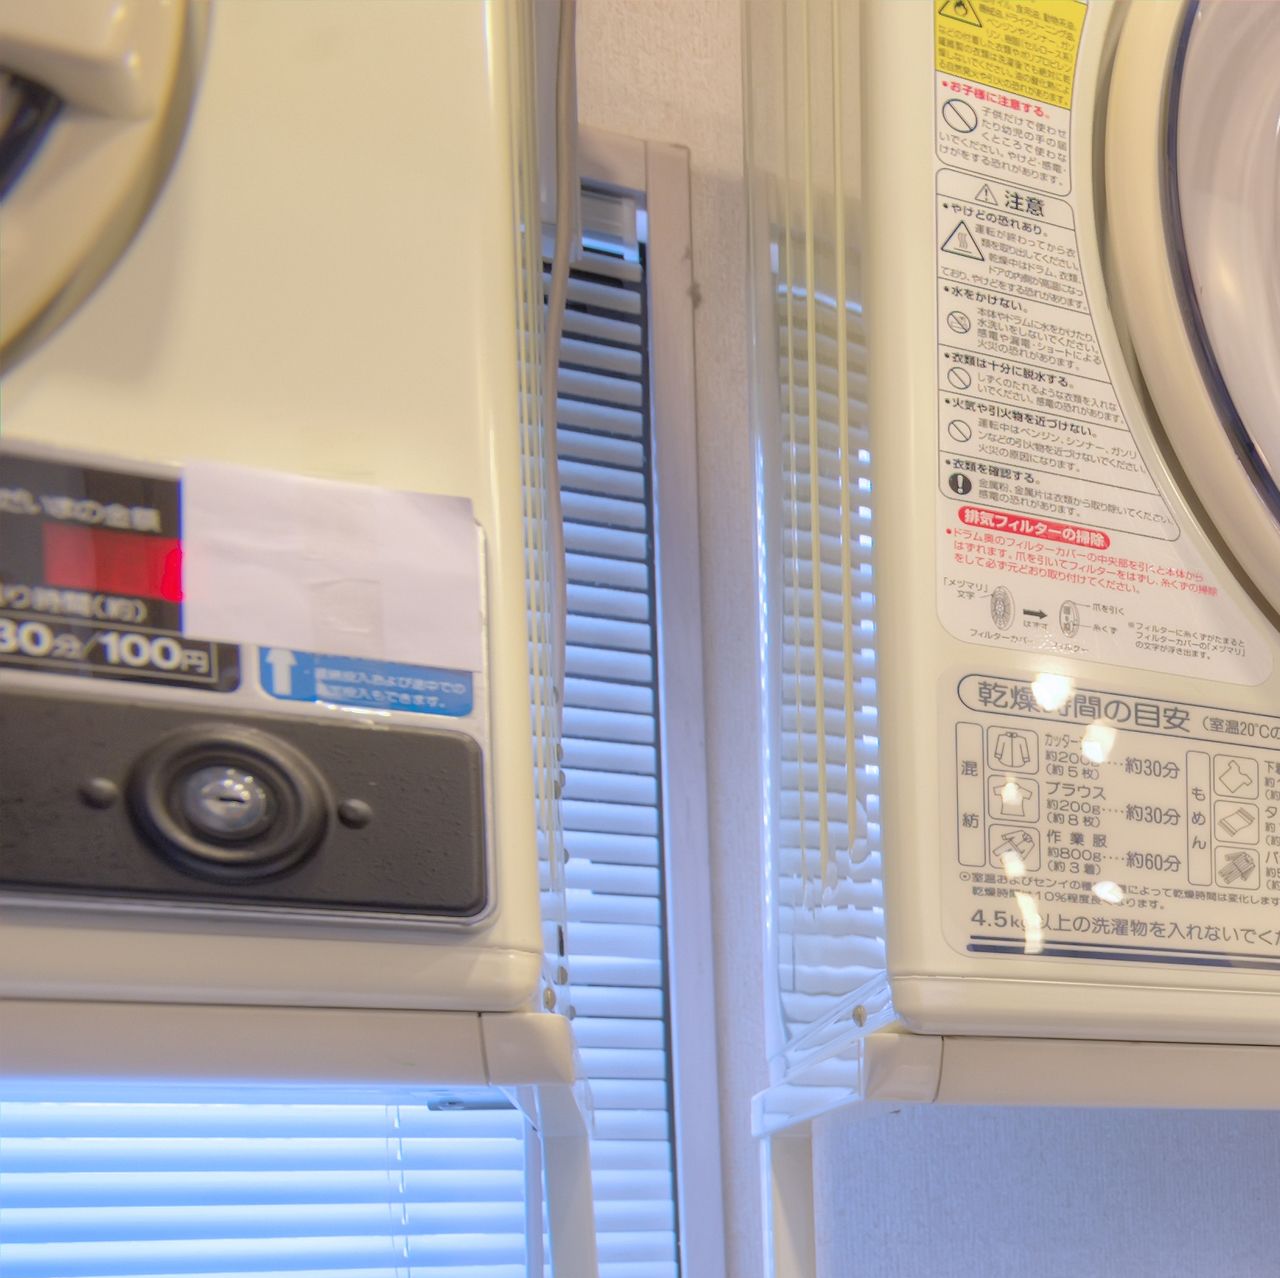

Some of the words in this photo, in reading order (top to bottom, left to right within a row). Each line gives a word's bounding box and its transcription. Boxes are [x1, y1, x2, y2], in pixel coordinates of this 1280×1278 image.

[950, 81, 1050, 119] お子様に注意する。
[981, 106, 1067, 139] 子供だけで使わせ
[981, 119, 1067, 151] たり幼児の手の届
[981, 131, 1067, 163] くところで使わな
[939, 144, 1063, 186] けがをする恐れがあります。
[1004, 189, 1045, 217] 注意
[951, 203, 1048, 237] やけどの恐れあり。
[975, 224, 1076, 258] 運転が終わってから衣
[951, 286, 1029, 313] 水をかけない。
[952, 352, 1074, 389] 衣類は十分に脱水する。
[977, 339, 1081, 371] 火災の恐れがあります。
[977, 373, 1118, 411] しずくのたれるような衣類を入れな
[952, 398, 1097, 439] 火気や引火物を近づけない。
[953, 458, 1041, 485] 衣類を確認する。
[978, 444, 1080, 473] 火災の原因になります。
[978, 489, 1081, 518] 感電の恐れがあります。
[963, 508, 1105, 550] 排気フィルターの掃除
[953, 528, 1205, 583] ドラム奥のフィルターカバーの中央部を引くと本体から
[953, 553, 1142, 596] をして必ず元どおり取り付けてください。
[1091, 602, 1126, 616] 爪を引く
[1125, 757, 1180, 780] 約30分
[961, 760, 979, 829] 混紡
[1046, 781, 1107, 801] ブラウス
[1125, 803, 1181, 826] 約30分
[1126, 851, 1182, 873] 約60分
